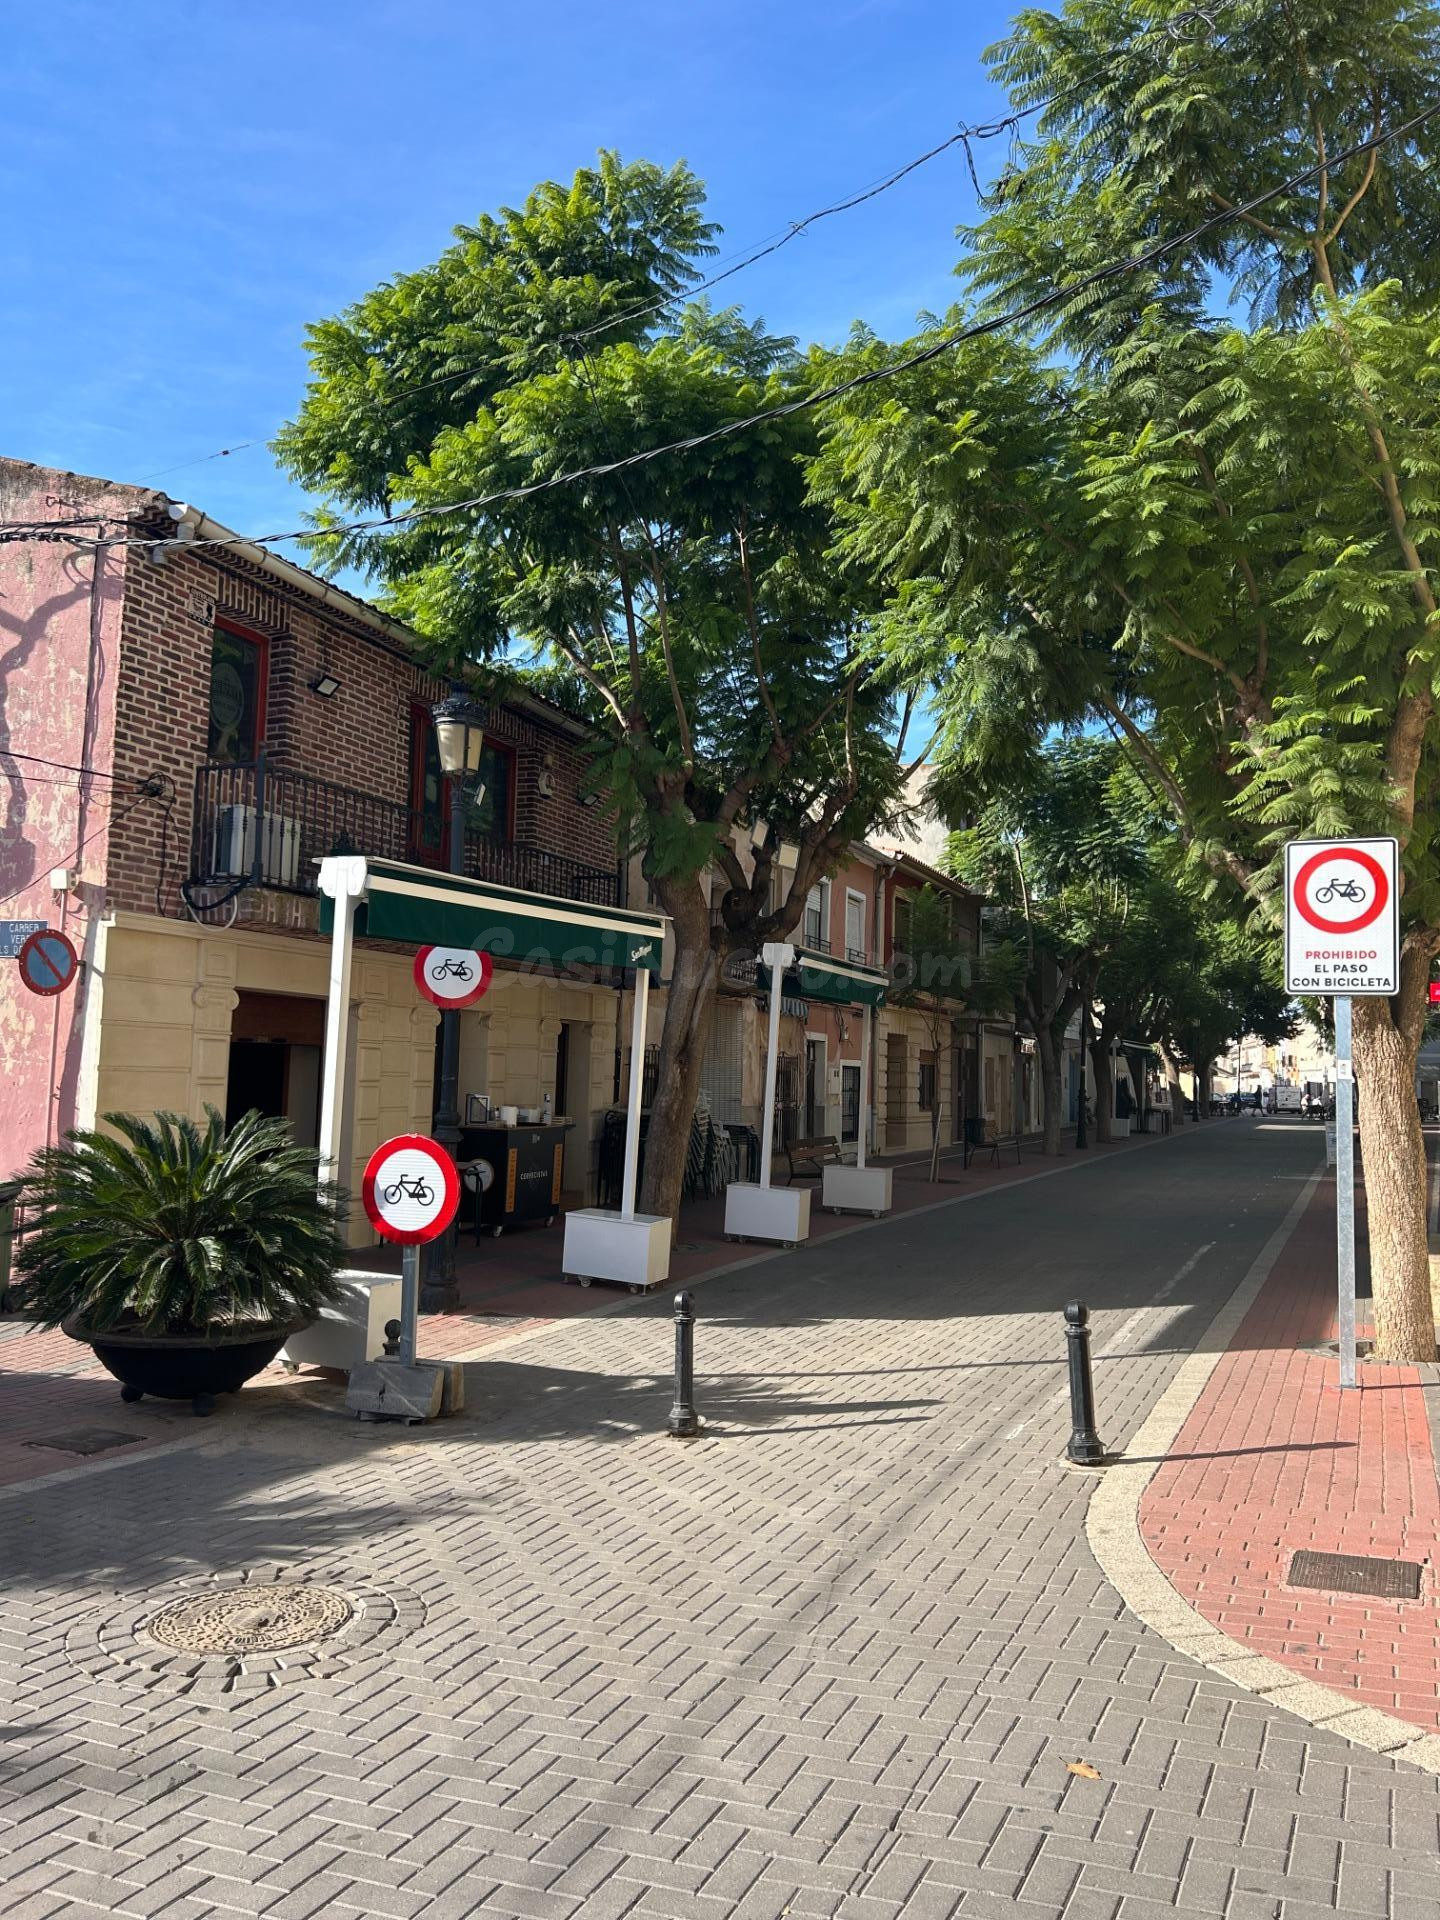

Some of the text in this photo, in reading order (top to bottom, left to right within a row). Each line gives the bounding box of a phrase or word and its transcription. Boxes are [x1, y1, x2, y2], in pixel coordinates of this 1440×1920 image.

[9, 923, 39, 933] CARRER
[1305, 950, 1377, 960] PROHIBIDO
[1314, 964, 1368, 973] EL PASO
[1292, 977, 1391, 987] CON BICICLETA
